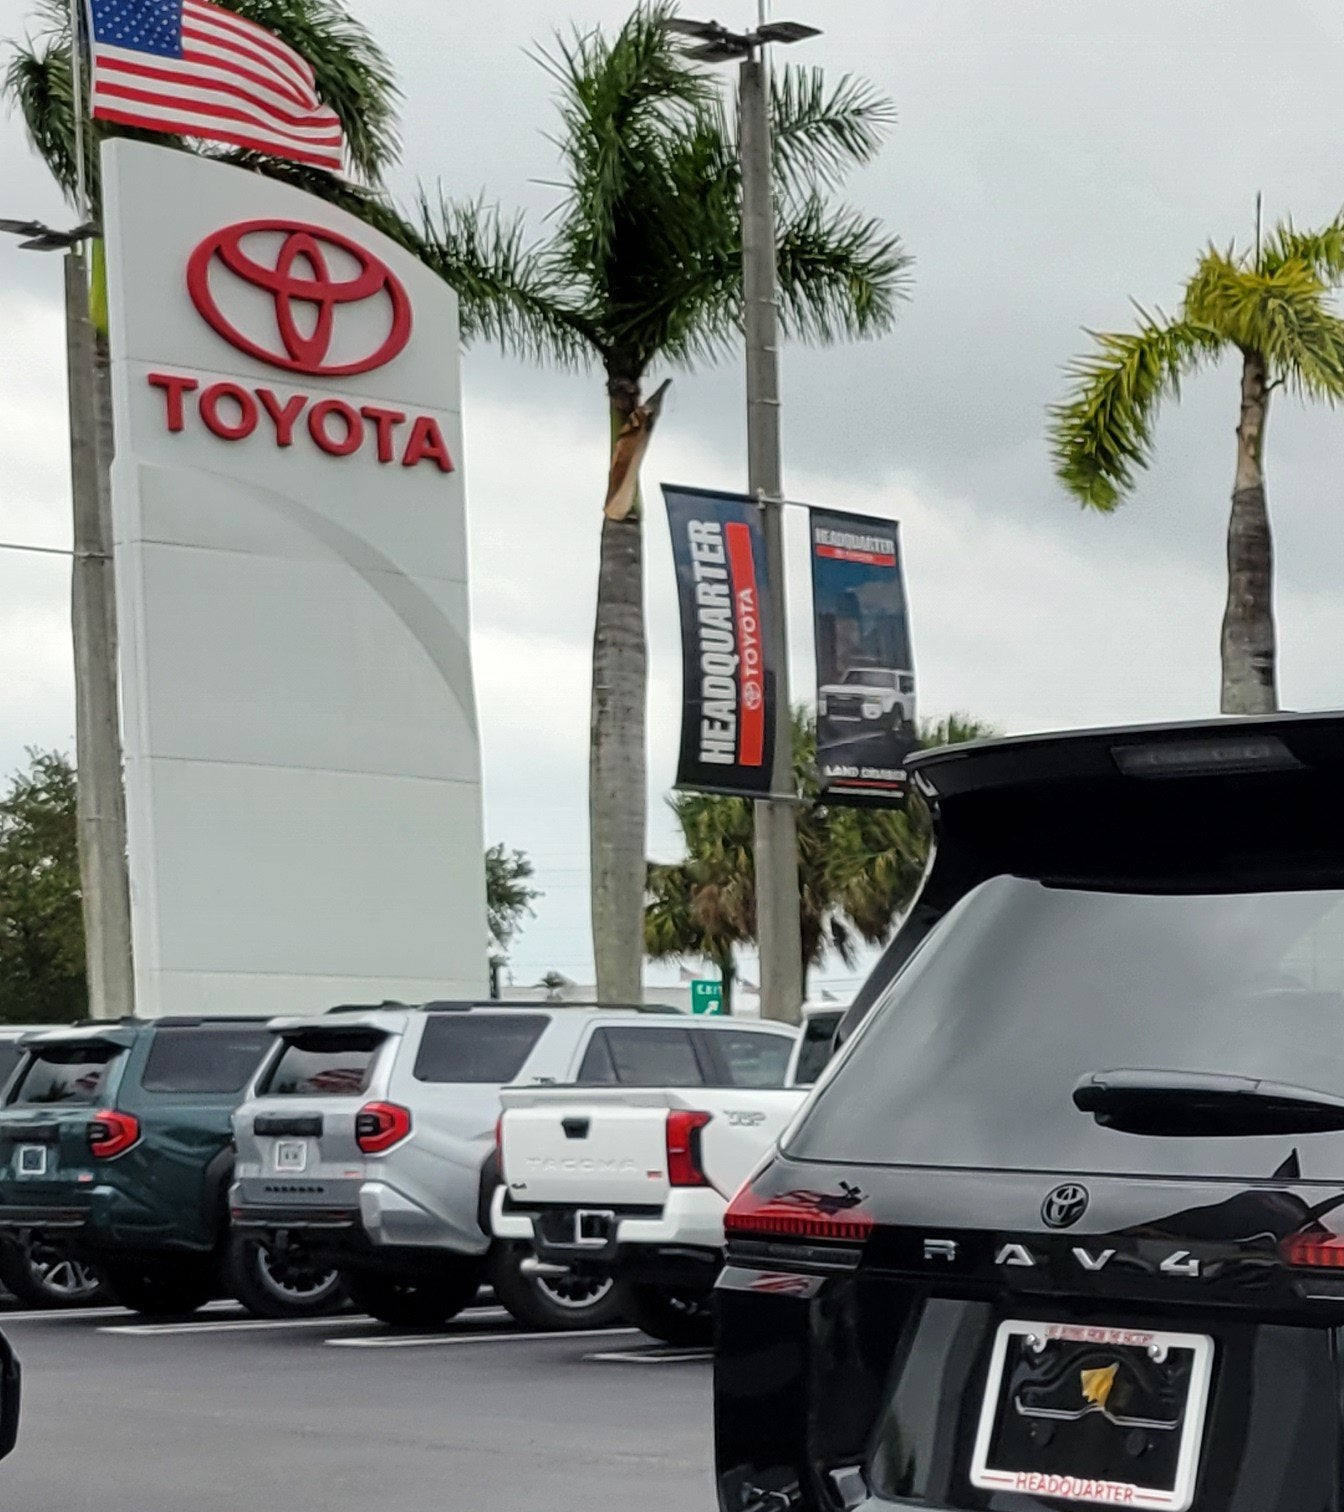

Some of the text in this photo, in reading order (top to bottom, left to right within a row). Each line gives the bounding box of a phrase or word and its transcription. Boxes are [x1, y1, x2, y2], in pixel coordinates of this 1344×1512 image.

[147, 372, 455, 473] TOYOTA
[687, 519, 739, 765] HEADQUARTER
[737, 588, 760, 680] TOYOTA
[924, 1239, 1199, 1277] RAV4
[1015, 1472, 1134, 1503] HEADQUARTER
